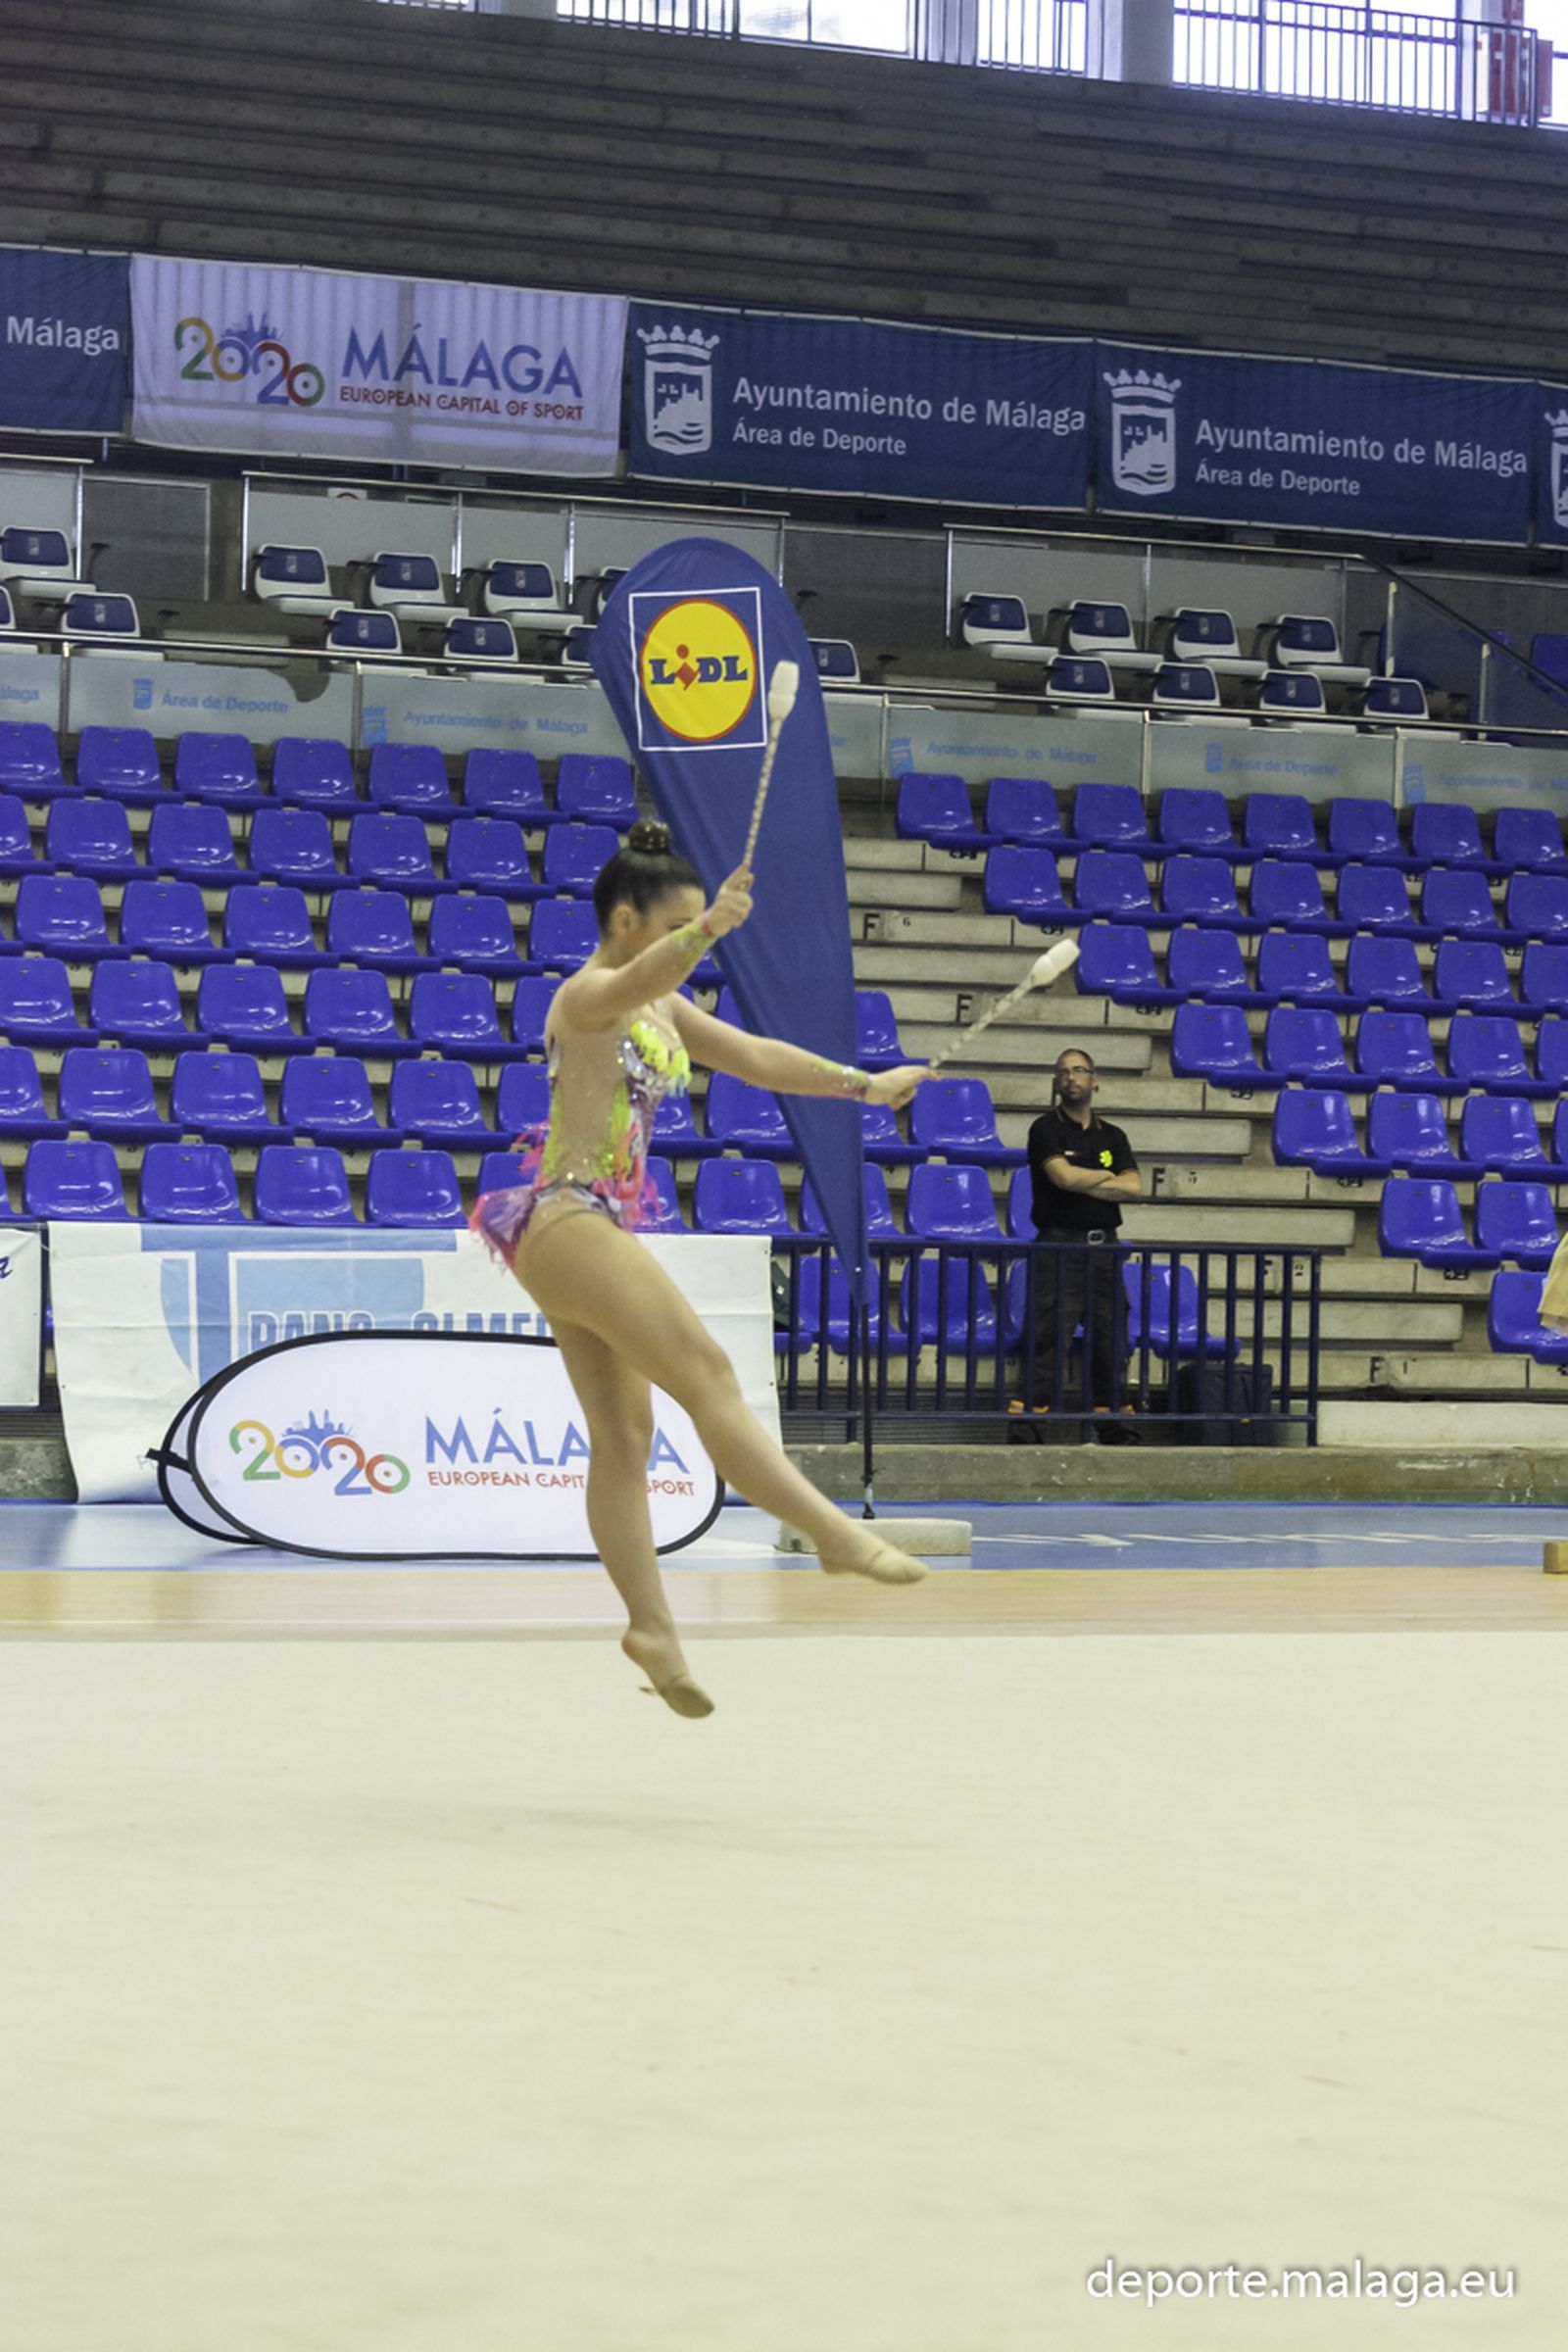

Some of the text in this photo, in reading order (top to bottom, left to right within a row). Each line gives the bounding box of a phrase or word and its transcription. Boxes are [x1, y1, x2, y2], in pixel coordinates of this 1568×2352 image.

[7, 317, 120, 356] Málaga
[342, 322, 583, 399] MÁLAGA
[174, 317, 325, 407] 2020
[340, 386, 585, 421] EUROPEAN CAPITAL OF SPORT
[733, 377, 1086, 436] Ayuntamiento de Málaga
[733, 416, 907, 456] Área de Deporte
[1195, 419, 1527, 477] Ayuntamiento de Málaga
[1195, 458, 1360, 496] Área de Deporte
[203, 693, 221, 708] de
[225, 694, 288, 713] Deporte
[228, 1419, 411, 1496] 2020
[425, 1407, 690, 1474] MÁLAA
[427, 1470, 530, 1488] EUROPEAN
